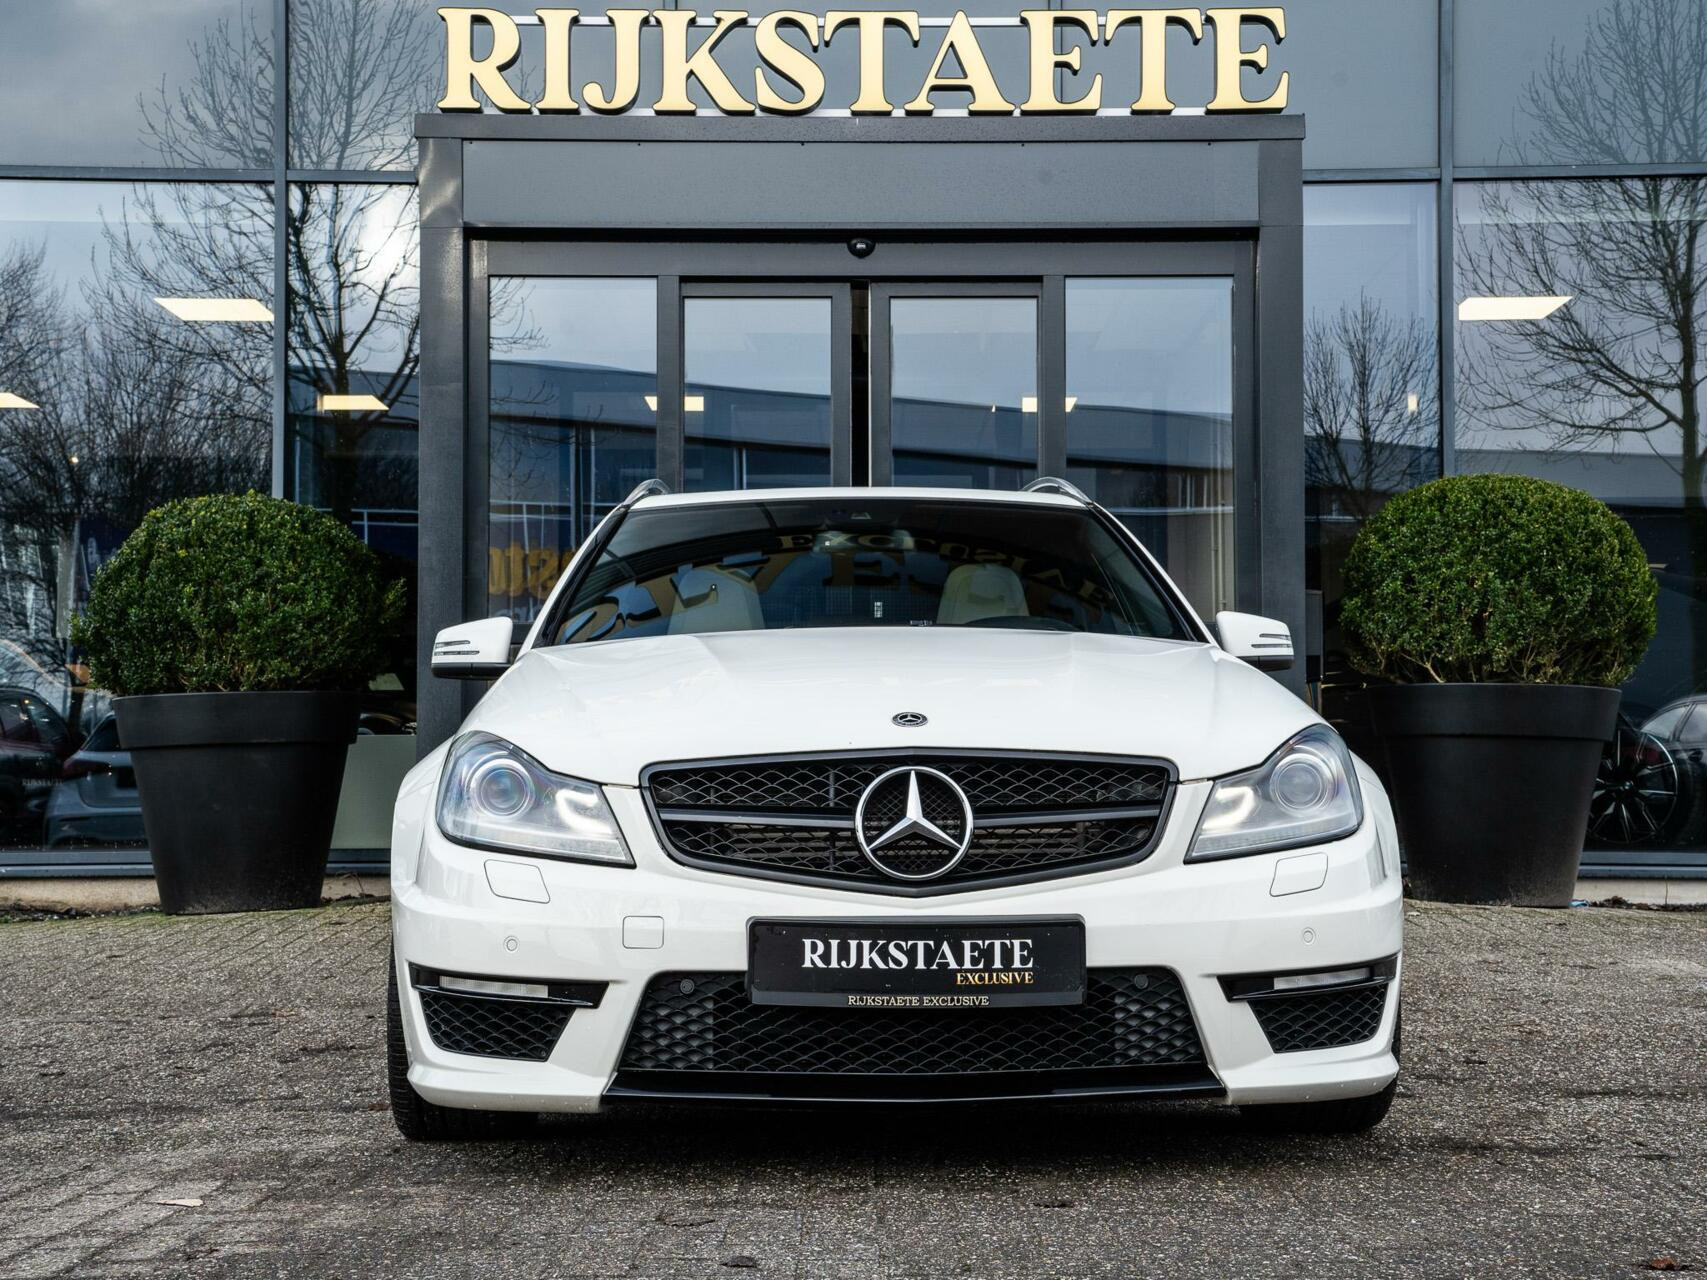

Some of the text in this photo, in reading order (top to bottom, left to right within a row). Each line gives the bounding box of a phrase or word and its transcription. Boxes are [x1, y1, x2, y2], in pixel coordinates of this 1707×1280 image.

[438, 7, 1290, 113] RIJKSTAETE
[801, 938, 1034, 969] RIJKSTAETE
[956, 972, 1034, 985] EXCLUSIVE
[848, 995, 990, 1007] RIJKSTAETE EXCLUSIVE
